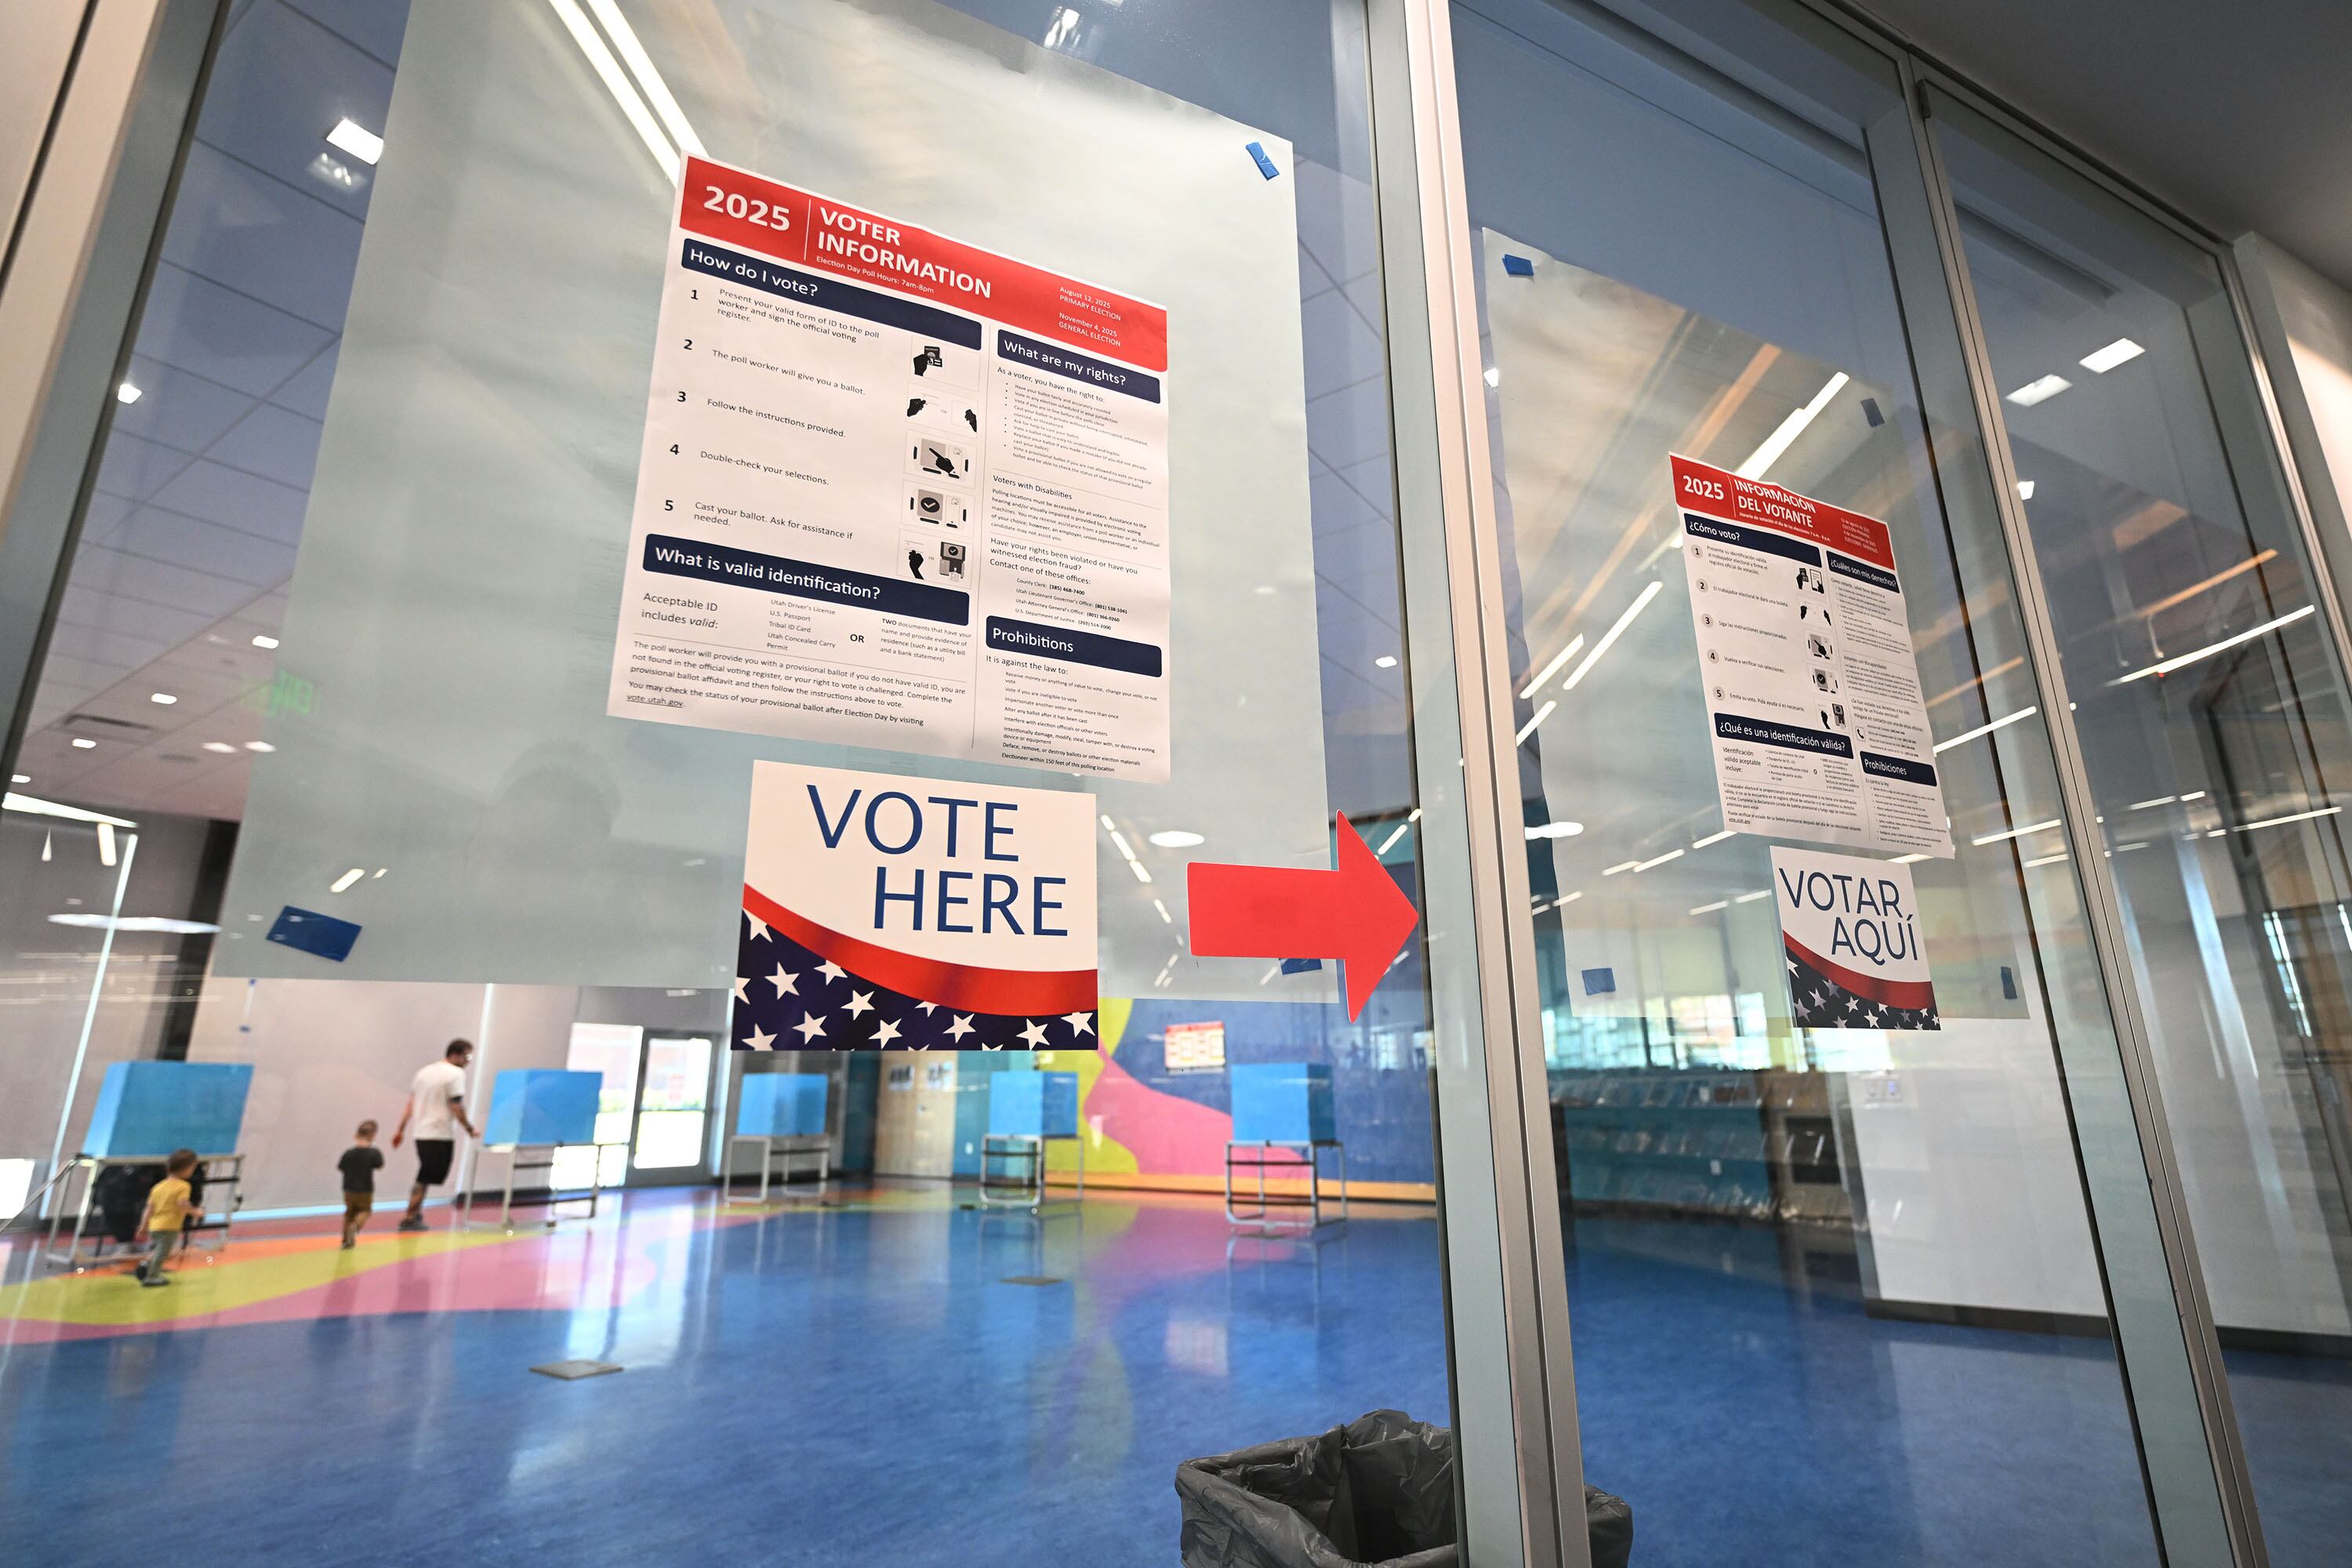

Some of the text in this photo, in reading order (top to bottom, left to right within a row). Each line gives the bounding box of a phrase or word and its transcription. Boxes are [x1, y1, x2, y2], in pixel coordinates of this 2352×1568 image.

[703, 185, 790, 231] 2025
[819, 206, 901, 246] VOTER
[690, 248, 818, 296] How do I vote?
[816, 256, 935, 294] Election Day Poll Hours: 7am-8pm
[818, 230, 991, 299] INFORMATION
[691, 289, 699, 300] 1
[1059, 286, 1111, 309] August 12, 2025
[717, 308, 751, 322] register.
[720, 289, 752, 303] Present
[753, 299, 773, 310] your
[775, 306, 794, 316] valid
[796, 310, 816, 322] form
[849, 325, 863, 335] the
[864, 330, 880, 339] poll
[1059, 294, 1121, 321] PRIMARY ELECTION
[718, 299, 857, 343] worker and sign the official voting
[1059, 312, 1093, 328] November
[1102, 326, 1117, 337] 2025
[684, 339, 693, 350] 2
[1058, 321, 1121, 347] GENERAL ELECTION
[712, 349, 729, 360] The
[731, 355, 747, 365] poll
[749, 360, 779, 372] worker
[781, 368, 796, 377] will
[797, 373, 815, 382] give
[816, 378, 832, 387] you
[840, 383, 866, 395] ballot.
[1004, 339, 1126, 386] What are my rights?
[996, 366, 1006, 375] As
[1013, 372, 1033, 383] voter,
[1034, 378, 1047, 387] you
[1048, 380, 1065, 391] have
[1066, 387, 1078, 395] the
[1079, 391, 1094, 400] right
[677, 390, 686, 402] 3
[707, 398, 846, 437] Follow the instructions provided.
[670, 444, 680, 456] 4
[700, 451, 829, 485] Double-check your selections.
[993, 474, 1016, 487] Voters
[1035, 485, 1073, 500] Disabilities
[1682, 475, 1725, 500] 2025
[1733, 479, 1817, 514] INFORMACIÓN
[664, 499, 673, 511] 5
[1737, 495, 1813, 528] DEL VOTANTE
[694, 514, 731, 527] needed.
[695, 502, 715, 512] Cast
[717, 507, 738, 516] your
[739, 510, 768, 523] ballot.
[770, 517, 786, 526] Ask
[788, 520, 800, 529] for
[802, 524, 845, 539] assistance
[1690, 521, 1740, 541] ¿Cómo voto?
[1695, 547, 1700, 556] 1
[655, 547, 880, 600] What is valid identification?
[989, 558, 1018, 571] Contact
[1019, 565, 1034, 574] one
[1044, 569, 1065, 579] these
[1065, 574, 1091, 585] offices:
[1850, 567, 1861, 576] son
[1700, 582, 1705, 590] 2
[643, 593, 718, 612] Acceptable ID
[787, 601, 812, 612] Driver's
[813, 606, 836, 615] License
[641, 609, 718, 629] includes valid:
[768, 620, 787, 629] Tribal
[796, 625, 811, 633] Card
[783, 612, 811, 622] Passport
[1705, 616, 1711, 625] 3
[767, 642, 788, 652] Permit
[784, 634, 818, 645] Concealed
[818, 640, 836, 648] Carry
[850, 633, 865, 644] OR
[993, 627, 1074, 652] Prohibitions
[1001, 659, 1028, 669] against
[1029, 662, 1043, 671] the
[1044, 664, 1057, 673] law
[1716, 689, 1722, 698] 5
[1719, 721, 1846, 751] ¿Qué es una identificación válida?
[1864, 758, 1907, 775] Prohibiciones
[806, 784, 1019, 862] VOTE
[874, 866, 1068, 936] HERE
[1778, 868, 1903, 918] VOTAR
[1831, 914, 1918, 966] AQUÍ
